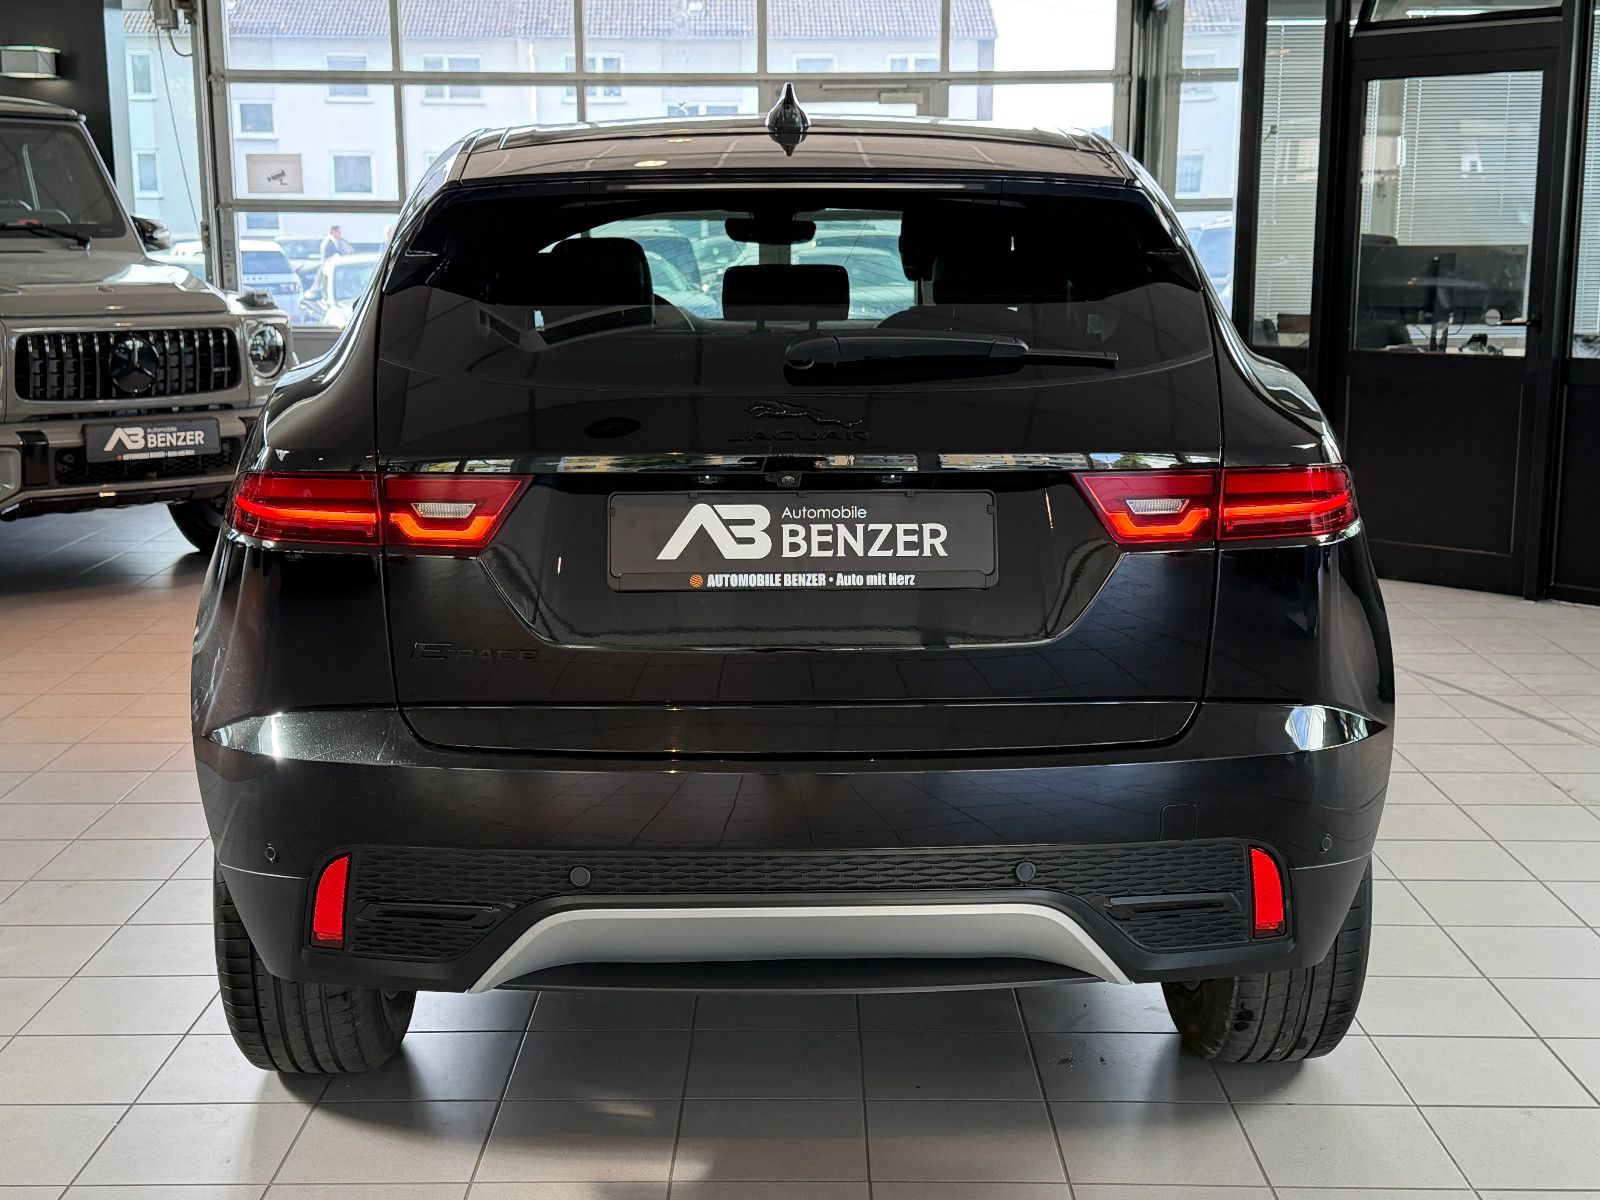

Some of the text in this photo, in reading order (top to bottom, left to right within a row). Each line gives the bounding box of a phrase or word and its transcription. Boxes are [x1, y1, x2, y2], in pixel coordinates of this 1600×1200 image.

[147, 430, 205, 449] BENZER
[727, 430, 868, 442] JAGUAR
[781, 506, 867, 519] Automobile
[781, 523, 949, 558] BENZER
[706, 572, 916, 588] AUTOMOBILE BENZER Auto mit Herz
